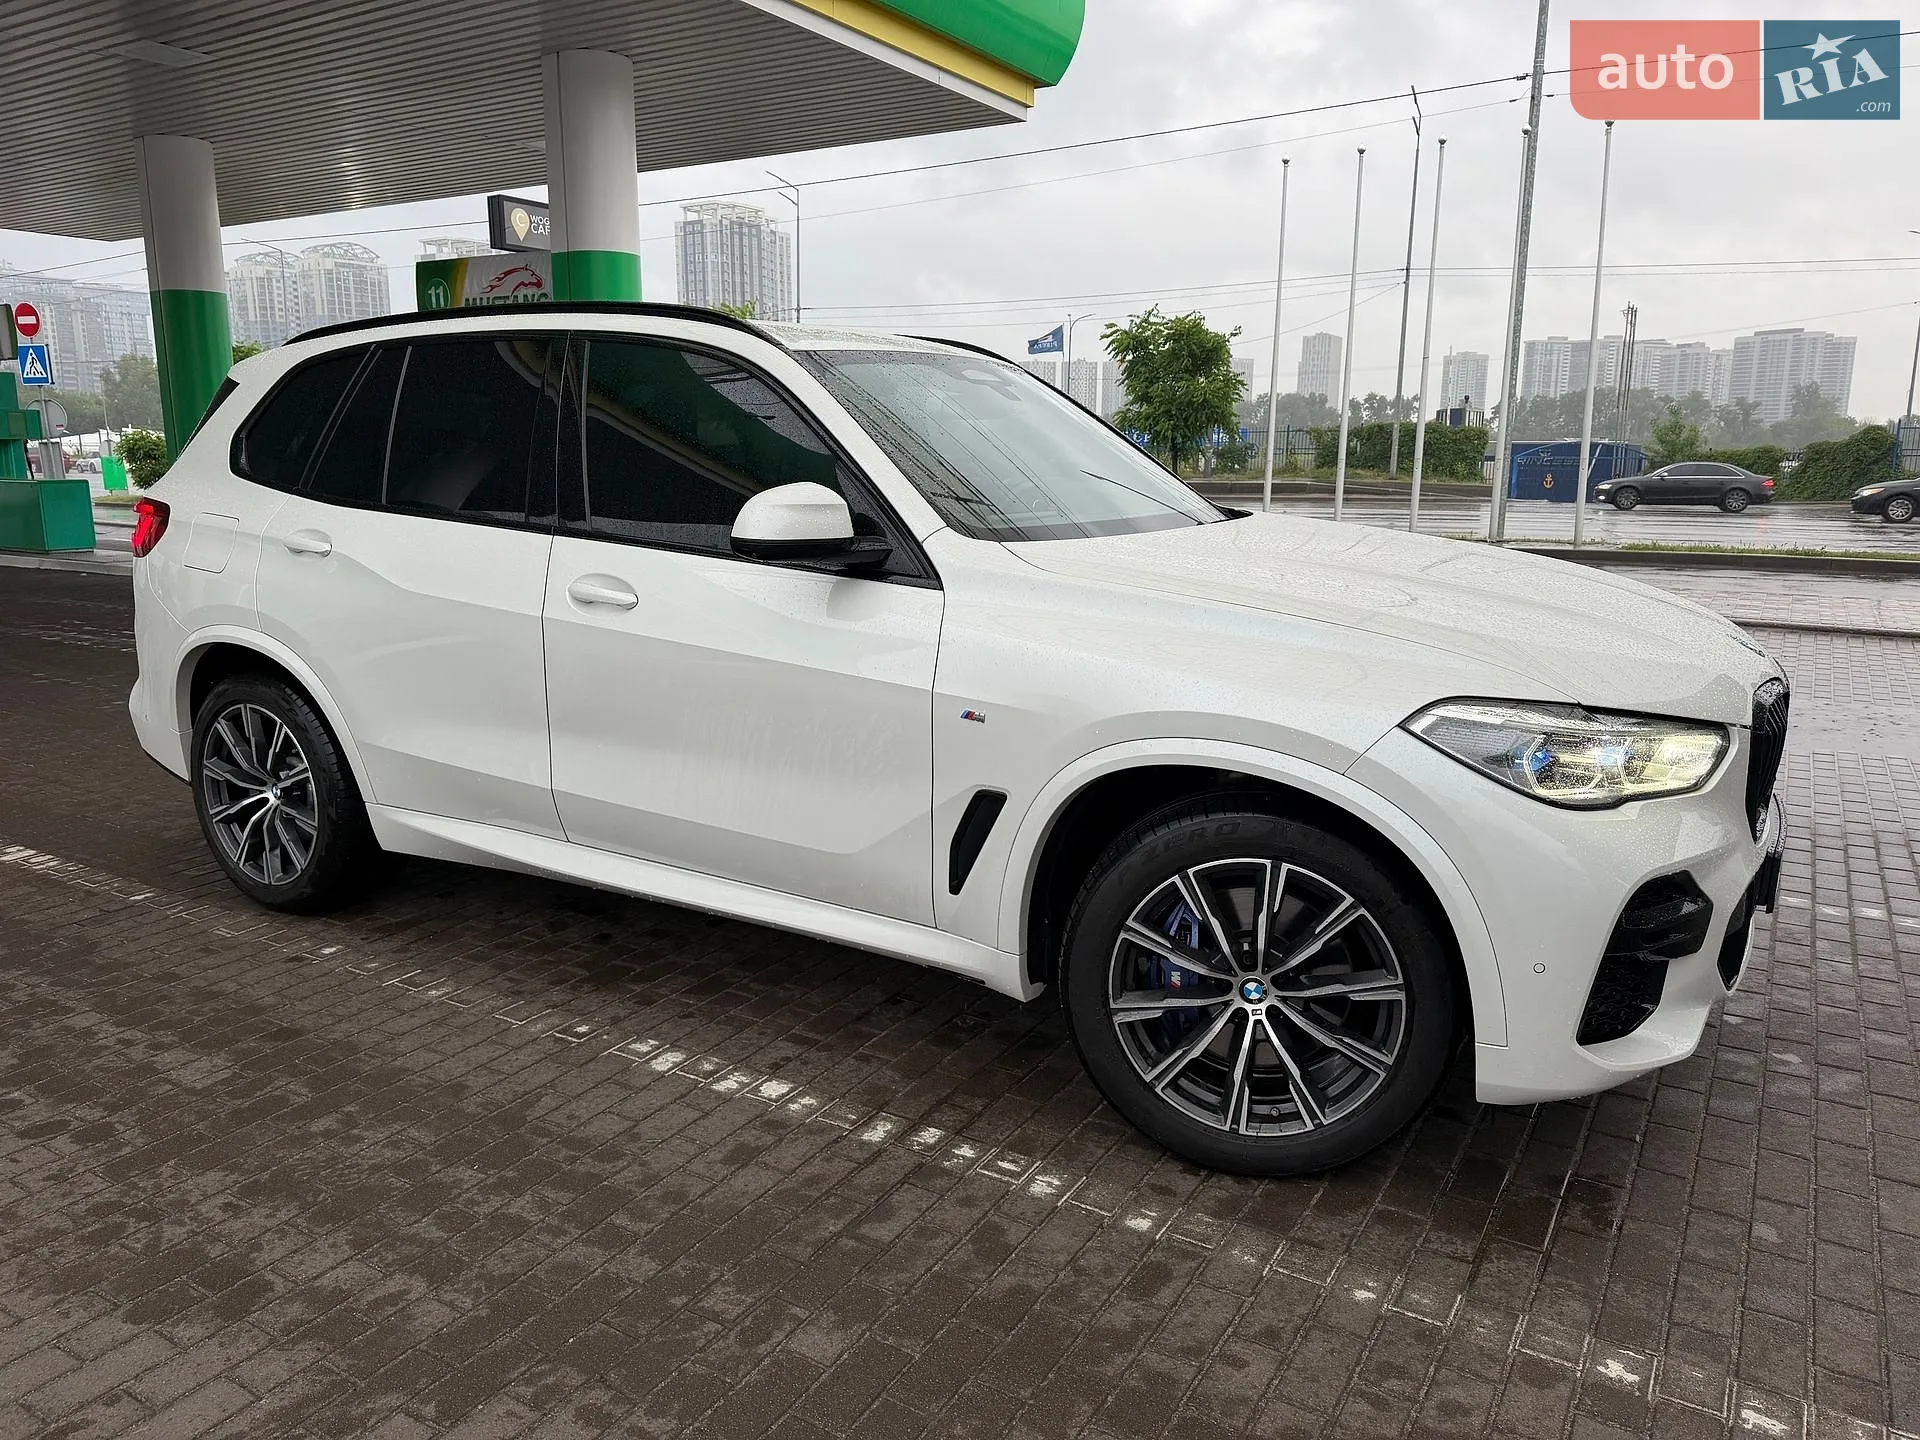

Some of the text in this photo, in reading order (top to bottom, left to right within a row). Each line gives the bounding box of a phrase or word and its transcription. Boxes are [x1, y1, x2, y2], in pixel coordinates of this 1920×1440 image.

[530, 215, 551, 226] WOG
[531, 223, 551, 236] CAF
[428, 286, 445, 308] 11
